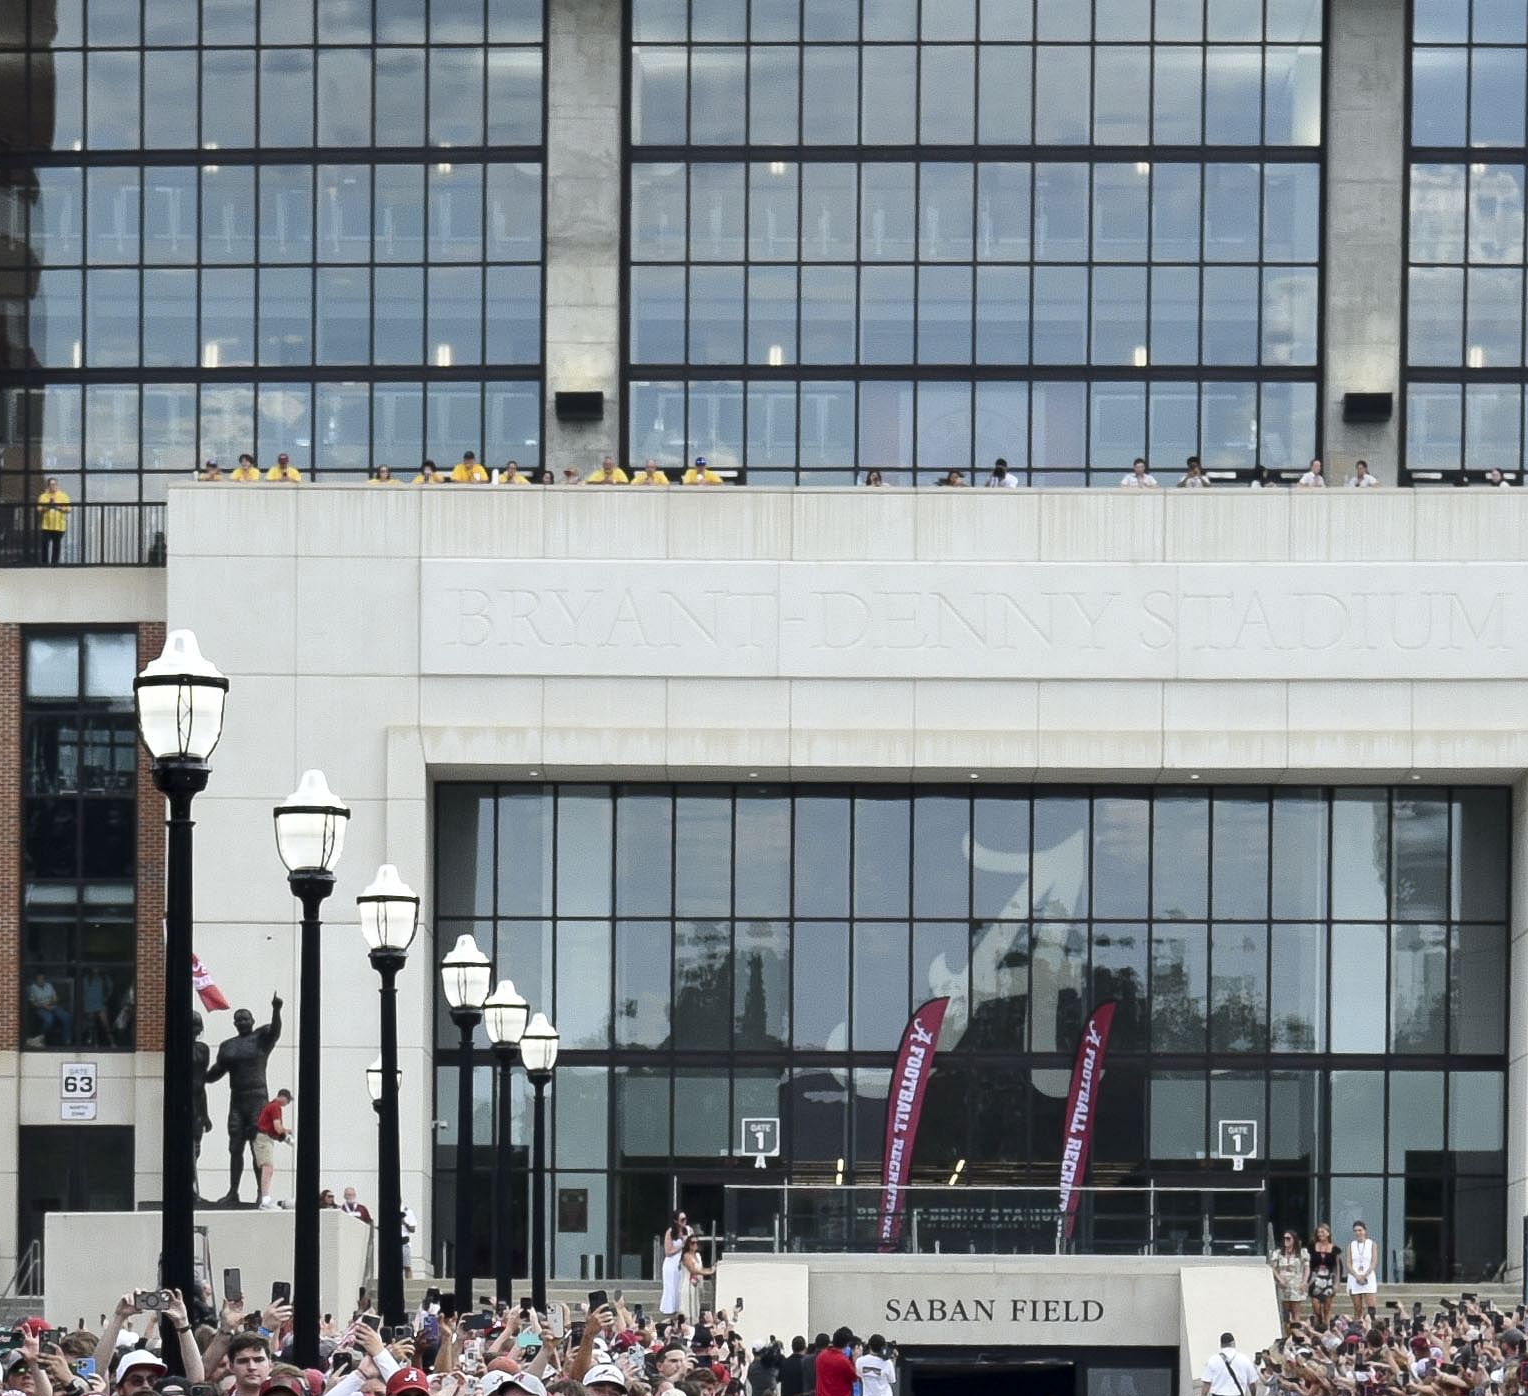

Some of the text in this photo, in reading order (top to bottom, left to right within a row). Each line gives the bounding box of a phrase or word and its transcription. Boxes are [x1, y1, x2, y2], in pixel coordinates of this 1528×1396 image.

[444, 588, 1514, 653] BRYANT-DENNY STADIUM
[64, 1076, 93, 1092] 63
[894, 1046, 927, 1133] FOOTBALL
[1070, 1048, 1096, 1133] FOOTBALL
[750, 1124, 771, 1132] GATE
[1227, 1126, 1249, 1135] GATE
[755, 1132, 764, 1150] 1
[1233, 1135, 1242, 1152] 1
[885, 1298, 1105, 1323] SABAN FIELD
